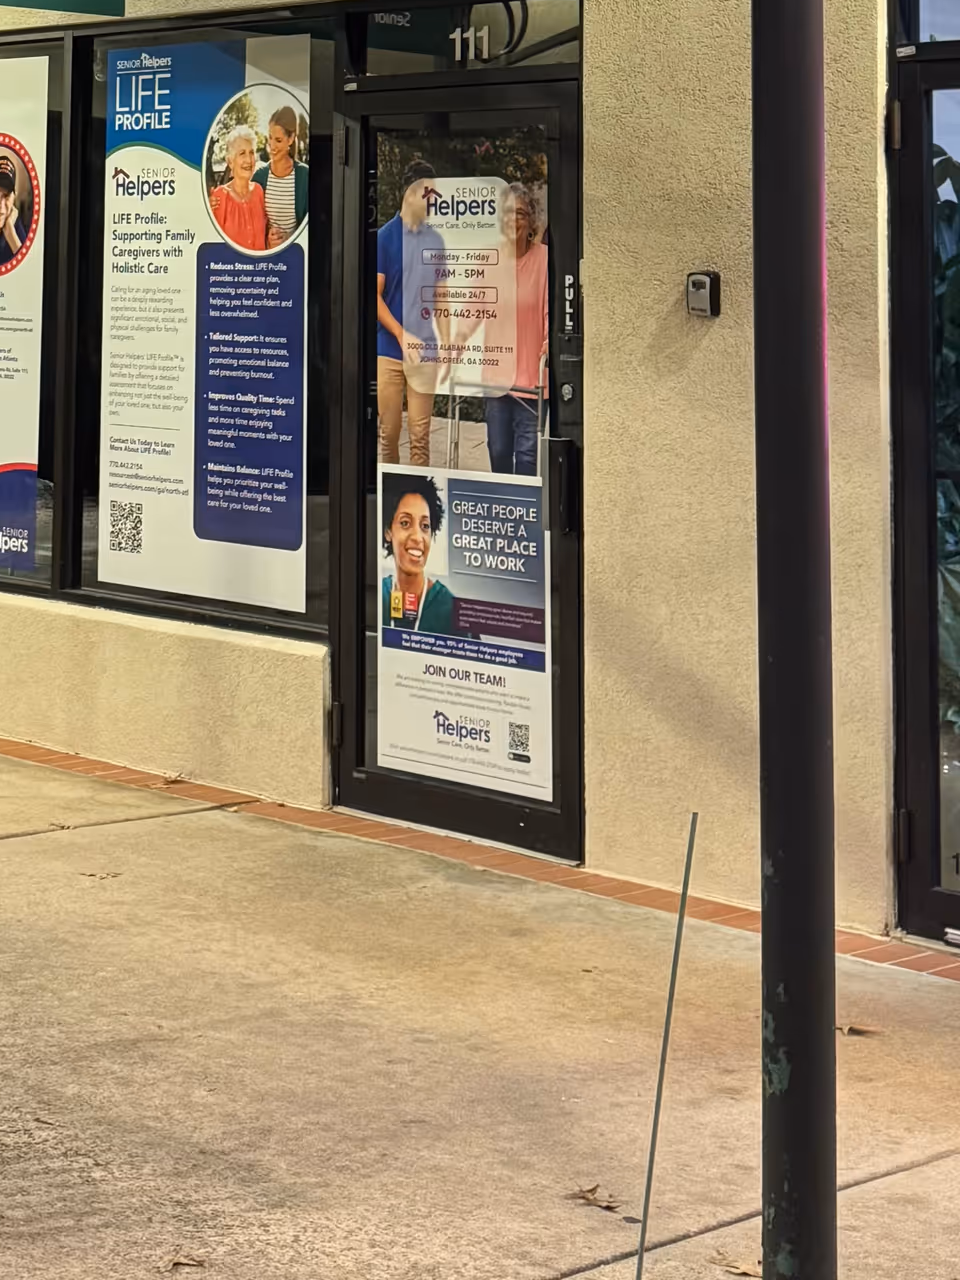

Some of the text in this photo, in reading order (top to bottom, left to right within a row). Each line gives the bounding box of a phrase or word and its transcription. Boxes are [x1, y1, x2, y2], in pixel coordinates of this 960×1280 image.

[449, 25, 489, 61] 111
[117, 56, 172, 69] SENIOR Helpers
[116, 74, 171, 112] LIFE
[115, 112, 171, 131] PROFILE
[141, 168, 176, 179] SENIOR
[116, 175, 176, 201] Helpers
[456, 187, 496, 198] SENIOR
[426, 195, 496, 221] Helpers
[113, 212, 167, 224] LIFE Profile:
[462, 222, 476, 230] Only
[112, 229, 195, 244] Supporting Family
[112, 245, 183, 260] Caregivers with
[431, 253, 460, 263] Monday
[466, 253, 490, 263] Friday
[112, 262, 168, 274] Holistic Care
[210, 262, 234, 271] Reduces
[256, 263, 267, 271] LIFE
[269, 263, 287, 271] Profile
[210, 274, 233, 283] provides
[435, 269, 456, 279] 9AM
[464, 269, 485, 279] 5PM
[210, 286, 279, 296] removing uncertainty and
[469, 291, 486, 300] 24/7
[210, 297, 230, 307] helping
[242, 298, 253, 306] feel
[254, 299, 280, 307] confident
[565, 275, 574, 326] PULL
[210, 309, 220, 317] less
[433, 309, 497, 319] 770-442-2154
[209, 332, 233, 341] Tailored
[234, 334, 258, 343] Support:
[220, 345, 233, 353] have
[440, 344, 470, 352] ALABAMA
[473, 345, 484, 353] RD,
[209, 391, 295, 405] Improves Quality Time: Spend
[110, 436, 128, 444] Contact
[138, 439, 152, 448] Today
[141, 447, 151, 455] LIFE
[208, 463, 235, 472] Maintains
[262, 468, 274, 477] LIFE
[275, 469, 293, 478] Profile
[452, 500, 537, 522] GREAT PEOPLE
[2, 527, 28, 538] SENIOR
[462, 518, 527, 538] DESERVE A
[452, 534, 537, 556] GREAT PLACE
[464, 552, 525, 573] TO WORK
[423, 664, 507, 688] JOIN OUR TEAM!
[460, 716, 490, 728] SENIOR
[437, 718, 491, 743] Helpers
